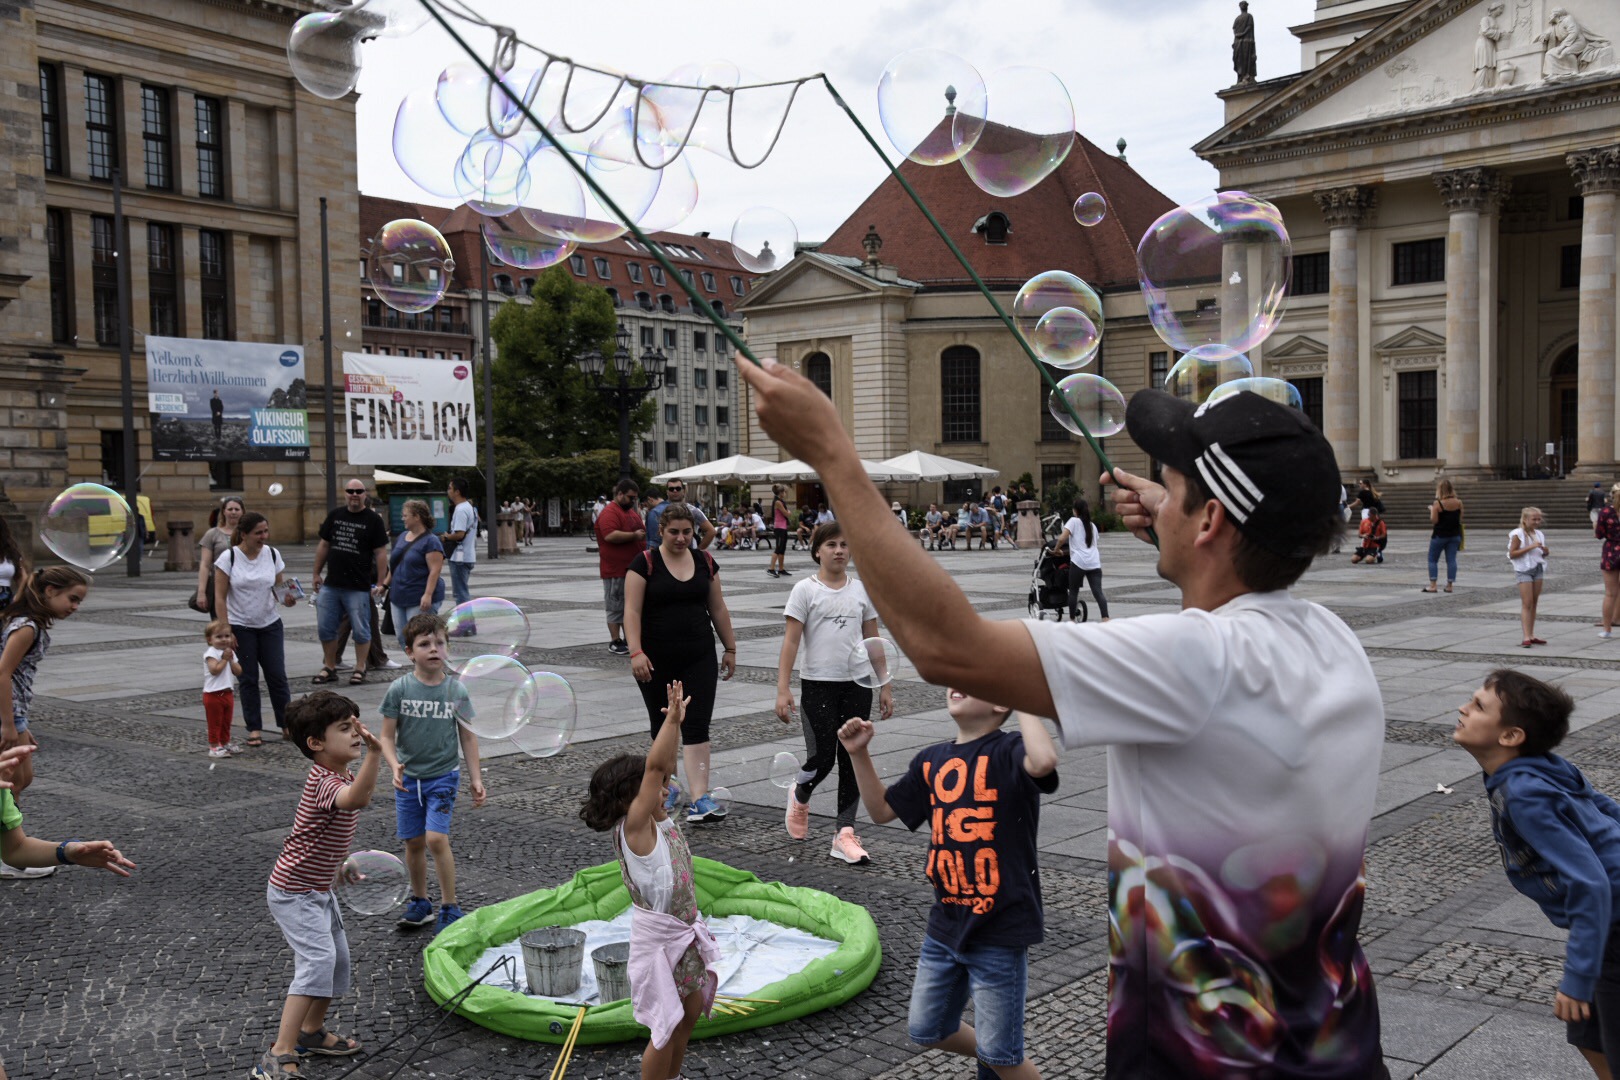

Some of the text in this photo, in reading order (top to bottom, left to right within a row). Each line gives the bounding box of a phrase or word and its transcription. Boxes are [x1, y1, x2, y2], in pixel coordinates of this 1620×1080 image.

[194, 354, 203, 367] &
[153, 368, 267, 387] Herzlich Willkommen
[349, 384, 369, 393] TRIFFT
[155, 394, 173, 402] ARTIST
[155, 403, 185, 412] RESIDENCE
[255, 408, 304, 427] VÍKINGUR
[350, 398, 473, 442] EINBLICK
[252, 426, 306, 444] ÓLAFSSON
[285, 448, 305, 457] Klavier
[434, 441, 454, 457] frei
